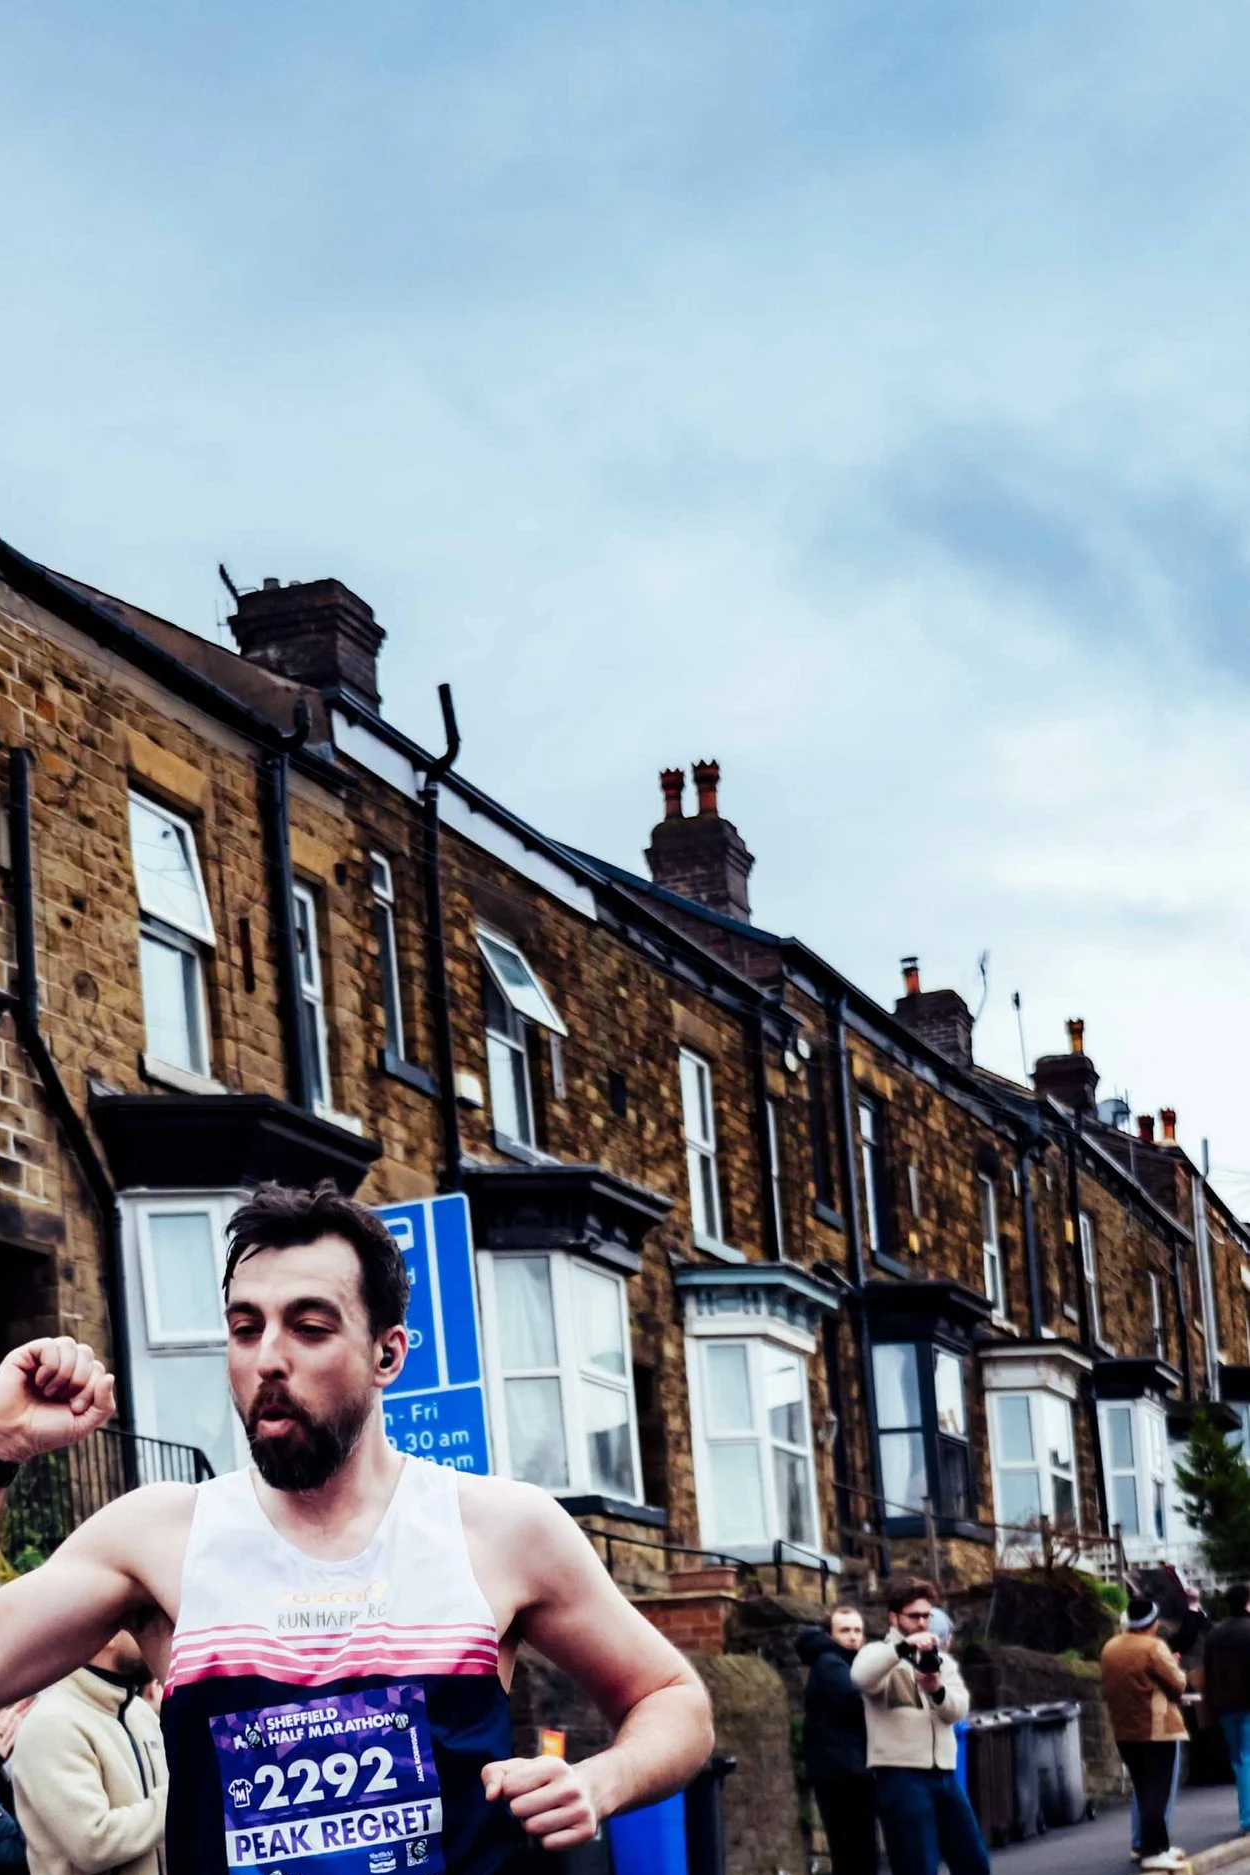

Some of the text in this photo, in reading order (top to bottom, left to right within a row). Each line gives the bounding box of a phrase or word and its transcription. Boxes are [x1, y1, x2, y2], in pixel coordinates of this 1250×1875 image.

[411, 1400, 438, 1423] Fri
[439, 1429, 470, 1448] am
[277, 1611, 310, 1630] RUN
[316, 1608, 362, 1628] HAPP
[266, 1707, 338, 1730] SHEFFIELD
[267, 1712, 396, 1745] HALF MARATHON
[254, 1746, 398, 1811] 2292
[415, 1764, 425, 1782] JACK
[234, 1804, 434, 1863] PEAK REGRET
